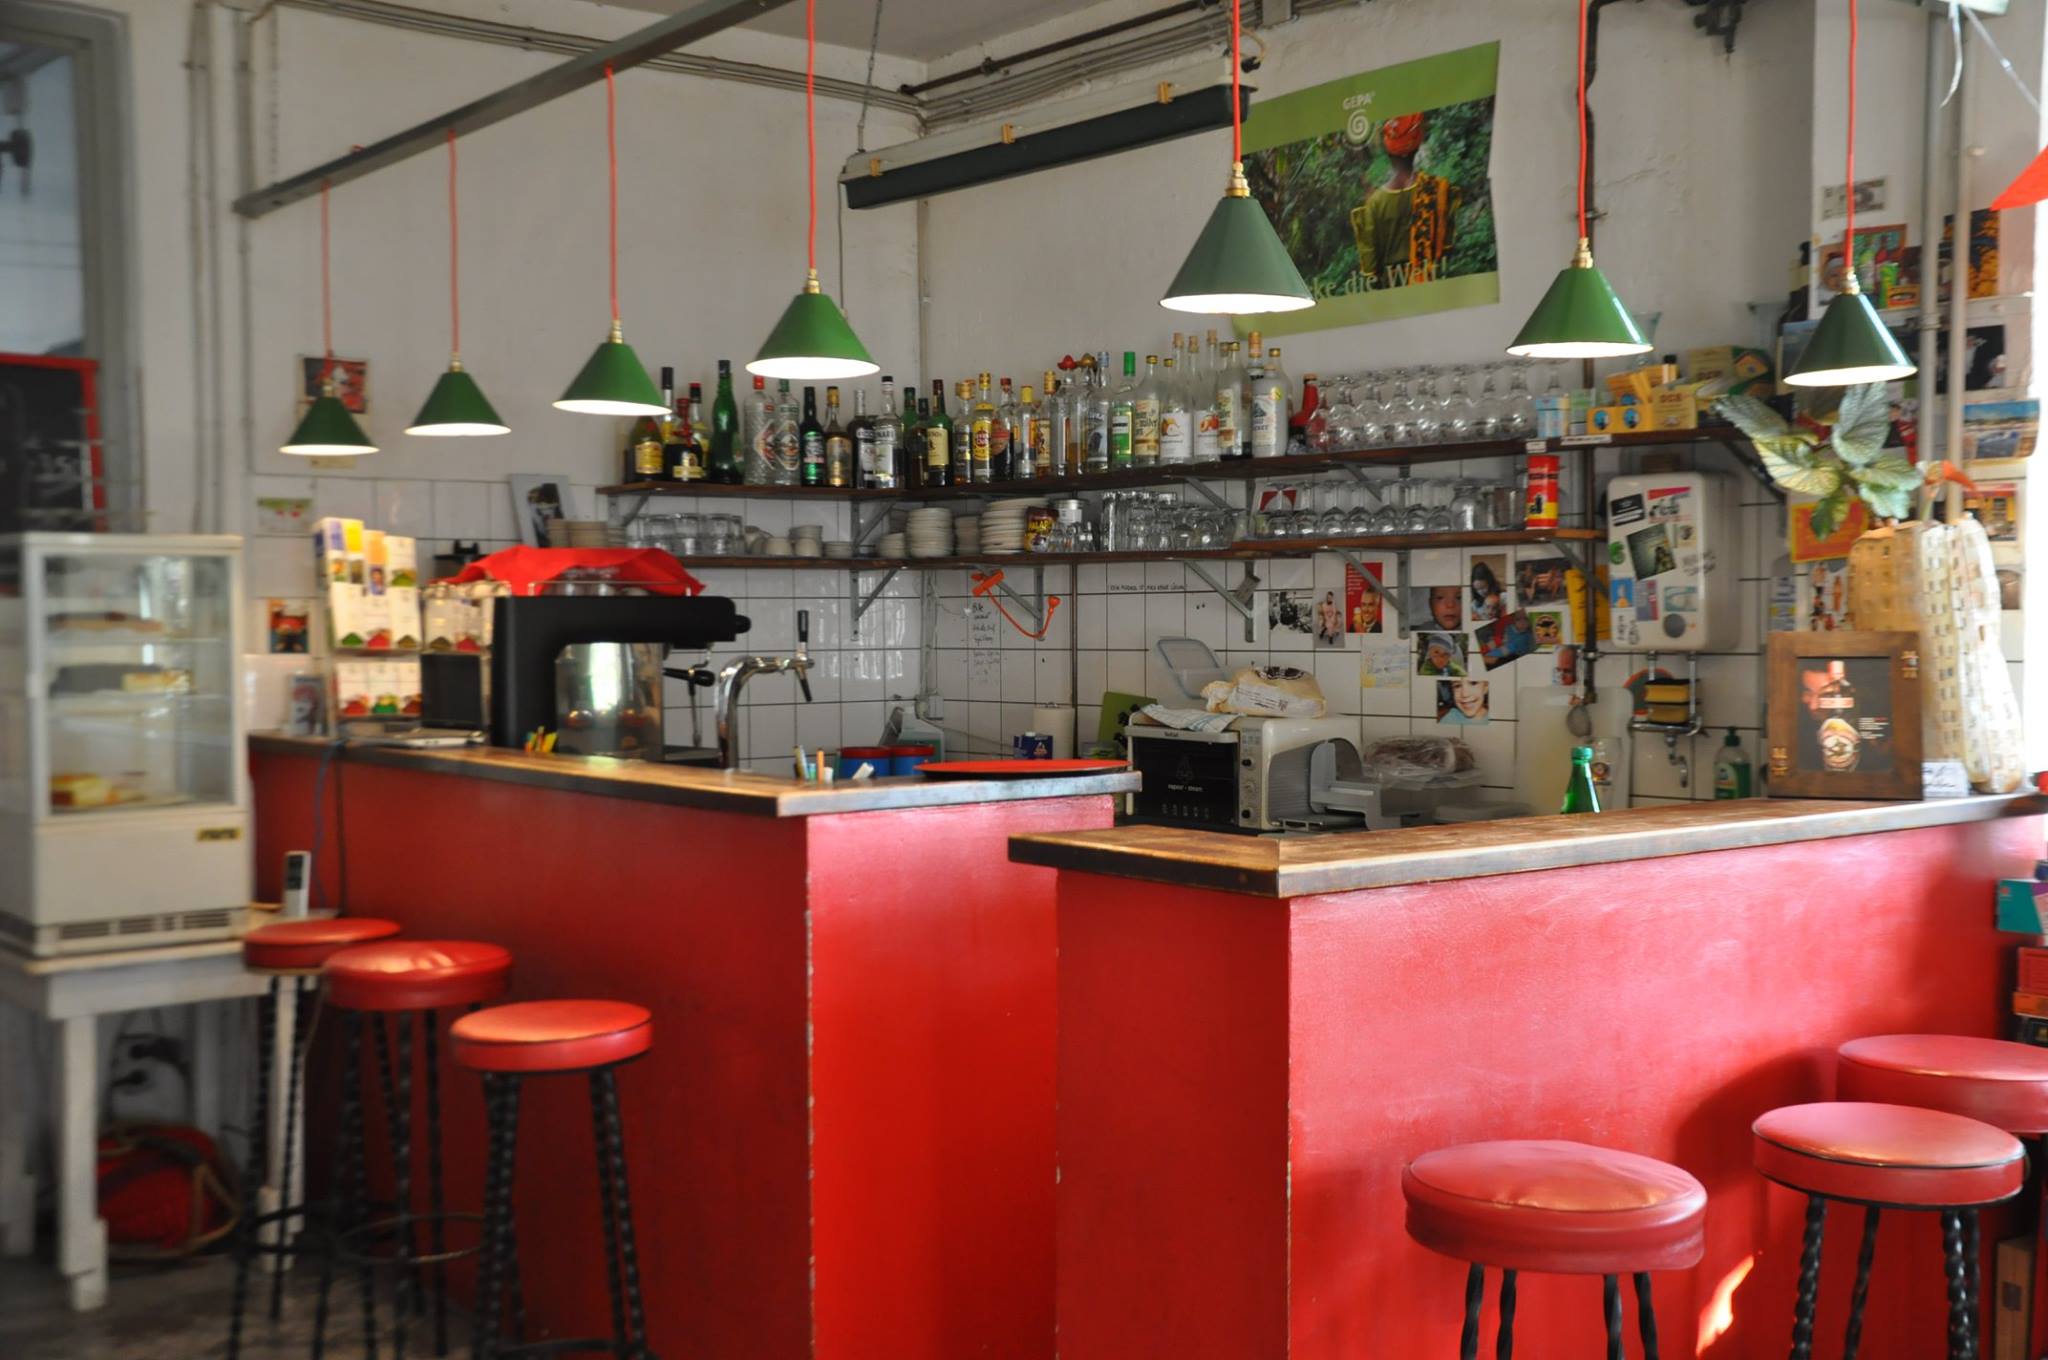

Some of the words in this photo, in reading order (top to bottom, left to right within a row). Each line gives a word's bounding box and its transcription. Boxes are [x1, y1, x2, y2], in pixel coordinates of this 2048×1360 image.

[1342, 94, 1372, 110] GEPA
[1310, 276, 1337, 299] ke
[1345, 269, 1377, 294] die
[1386, 255, 1447, 289] Welt!
